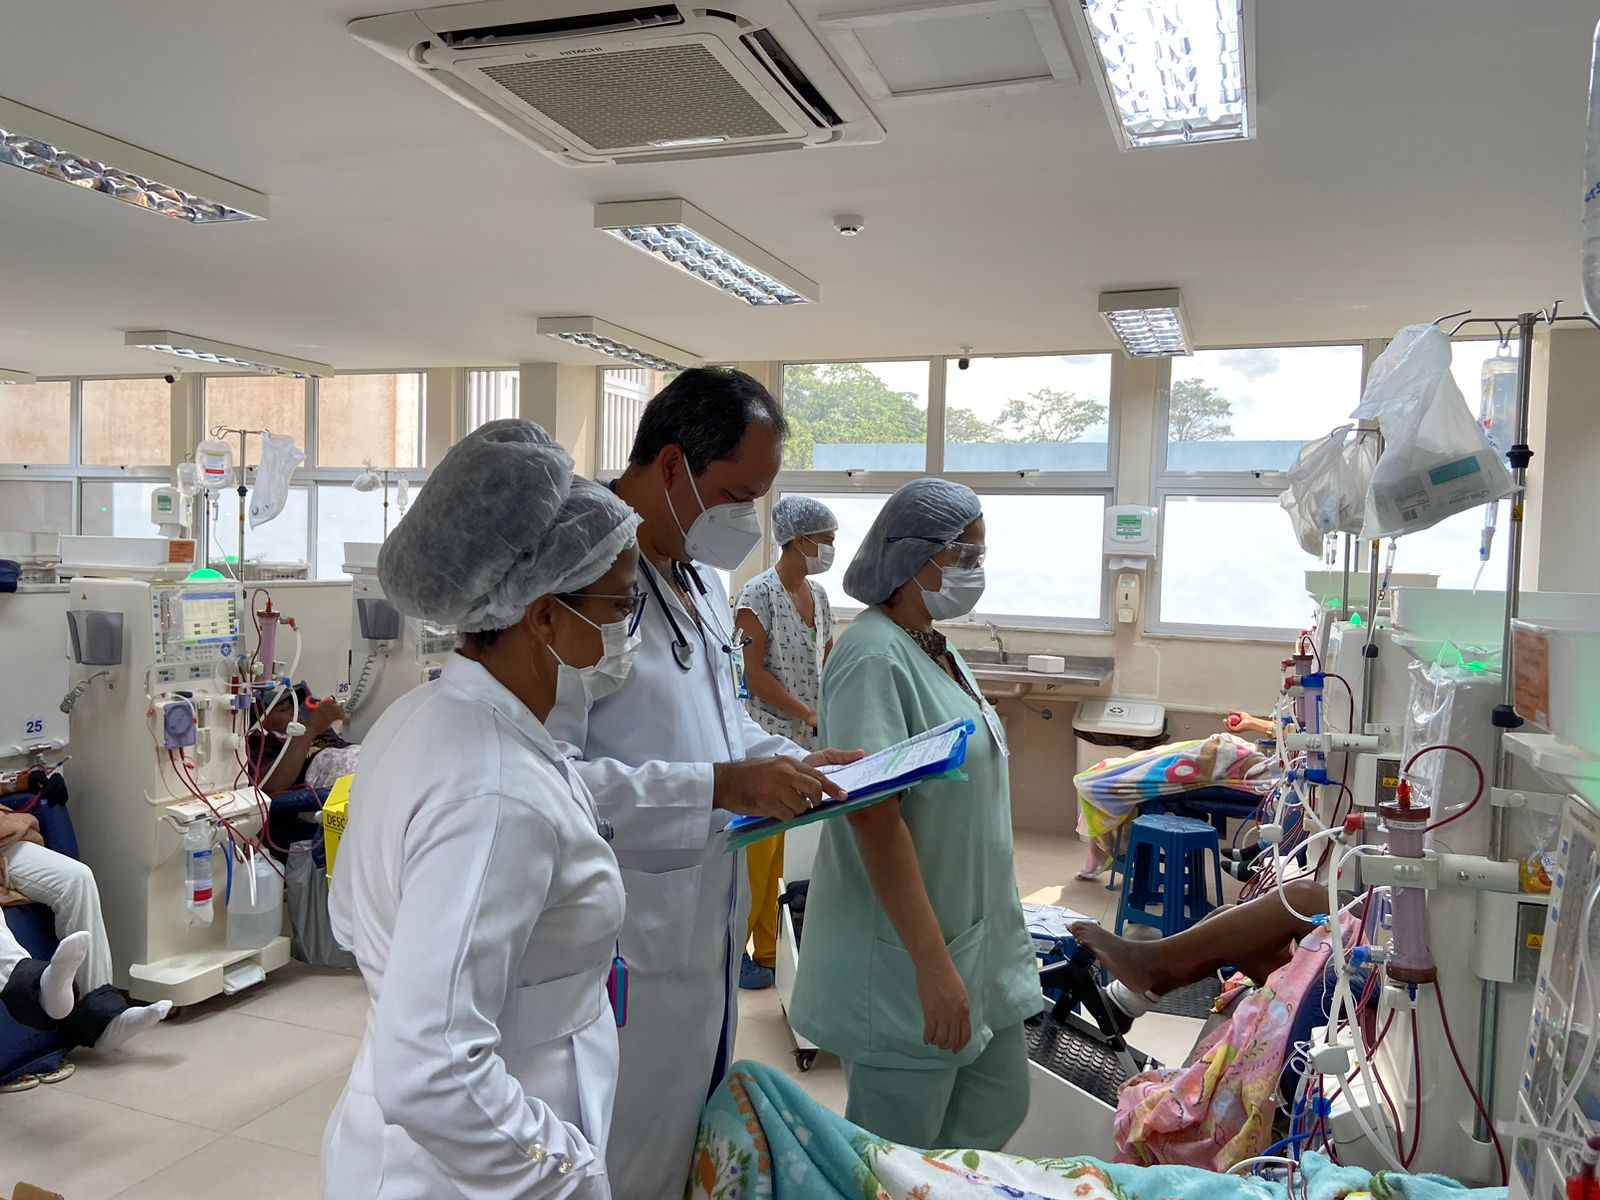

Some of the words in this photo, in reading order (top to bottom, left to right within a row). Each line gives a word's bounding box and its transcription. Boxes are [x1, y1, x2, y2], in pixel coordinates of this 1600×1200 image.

[559, 46, 603, 56] HITACHI
[338, 683, 348, 692] 26
[26, 720, 43, 734] 25
[326, 813, 347, 829] DESC
